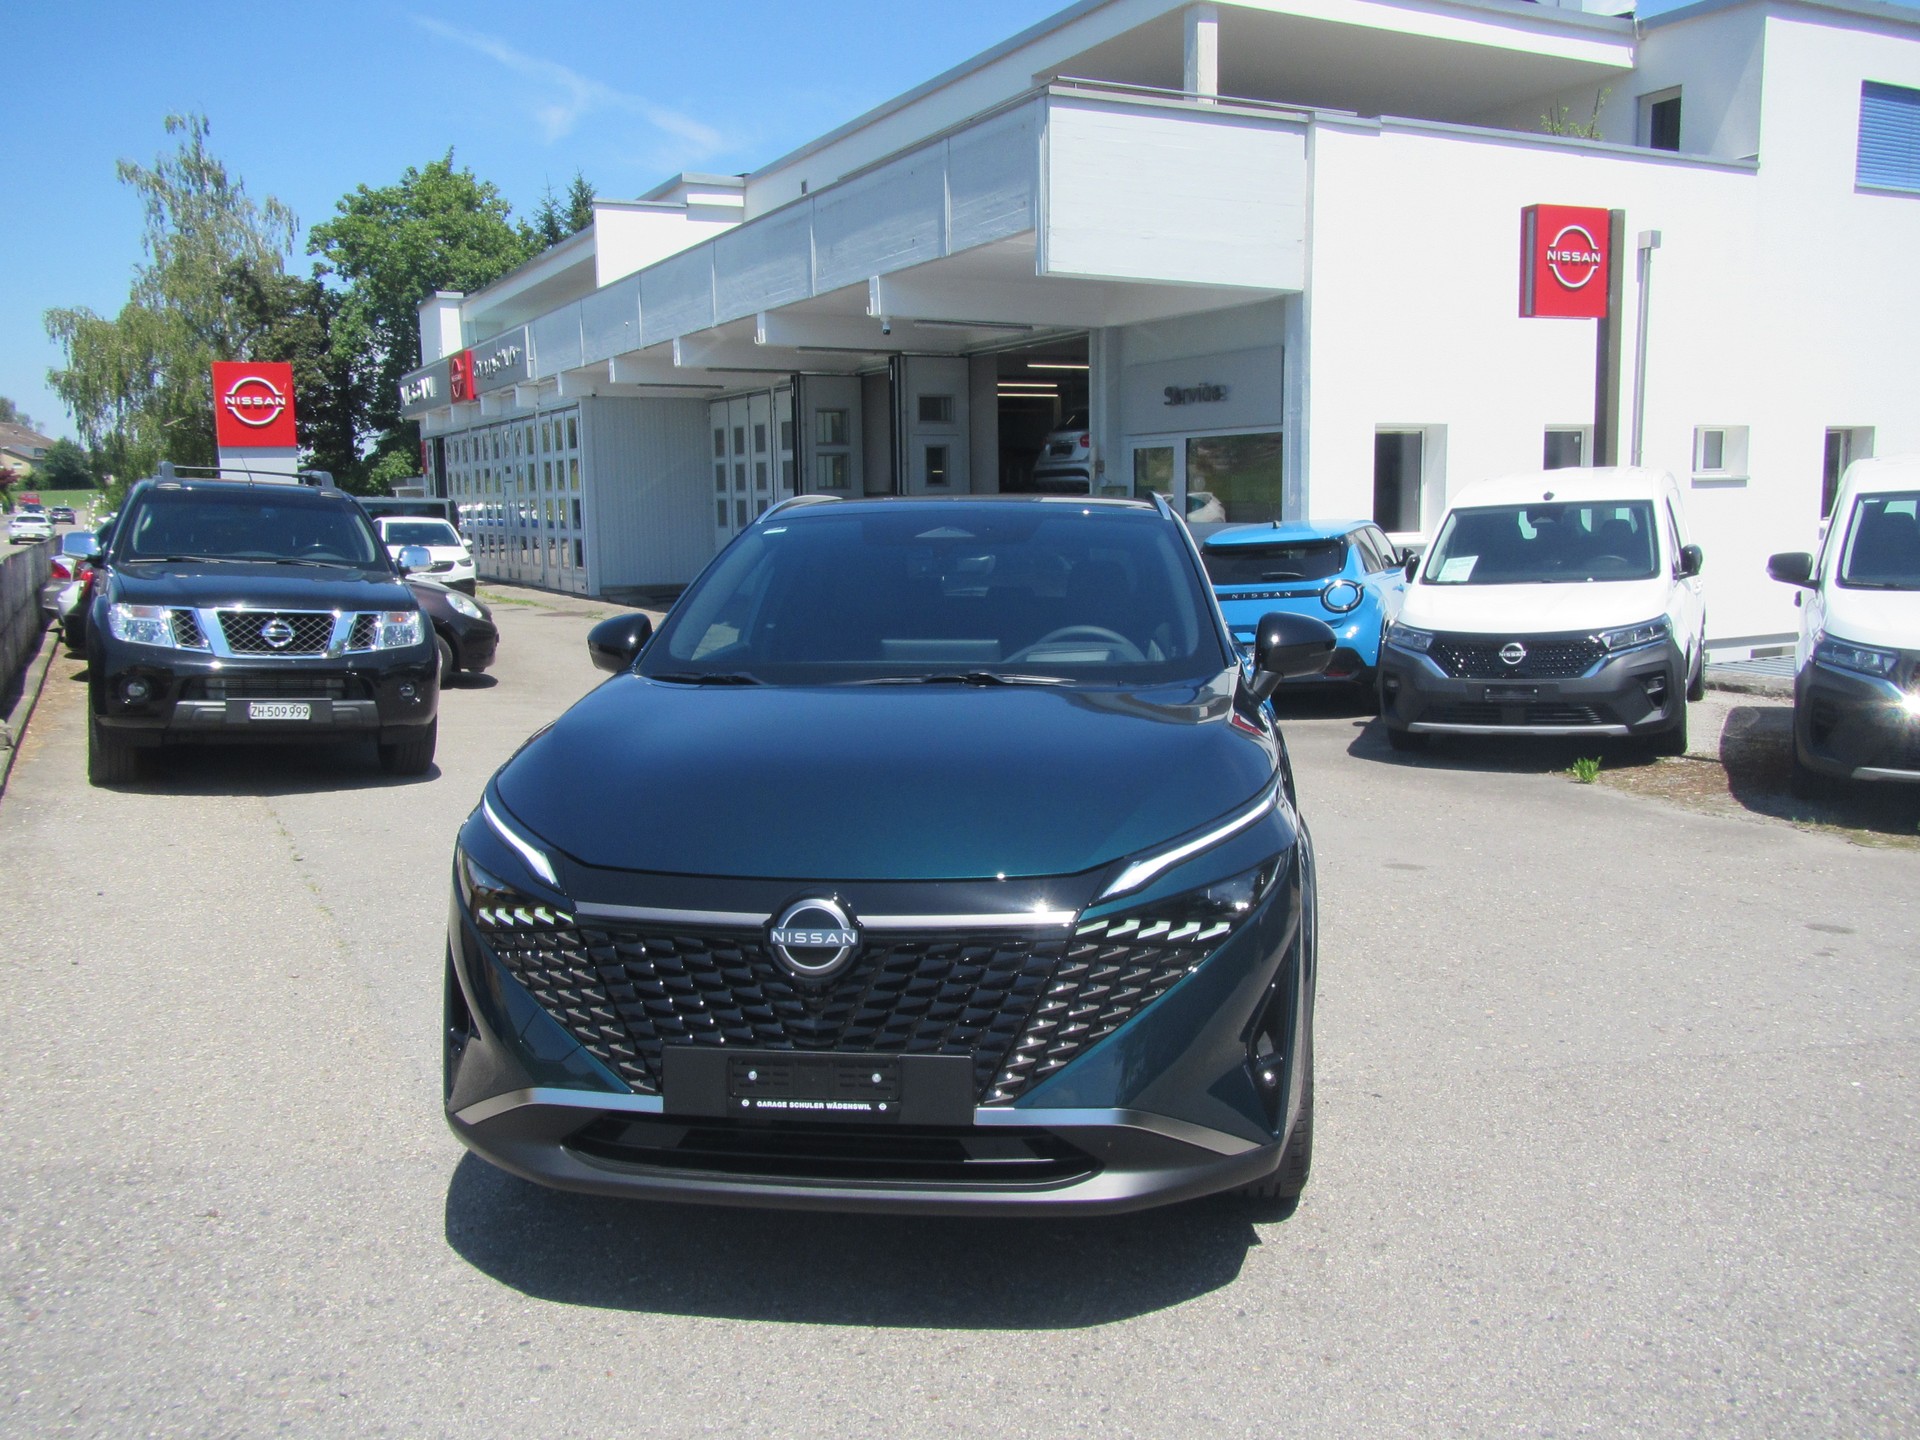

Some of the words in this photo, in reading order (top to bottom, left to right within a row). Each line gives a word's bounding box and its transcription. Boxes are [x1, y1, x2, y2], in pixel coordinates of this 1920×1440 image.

[1547, 250, 1601, 263] NISSAN
[224, 396, 286, 406] NISSAN
[1231, 591, 1292, 599] NISSAN
[772, 931, 856, 944] NISSAN
[756, 1101, 787, 1109] GARAGE
[789, 1101, 825, 1110] SCHULER
[826, 1102, 872, 1111] WÄDENSWIL
